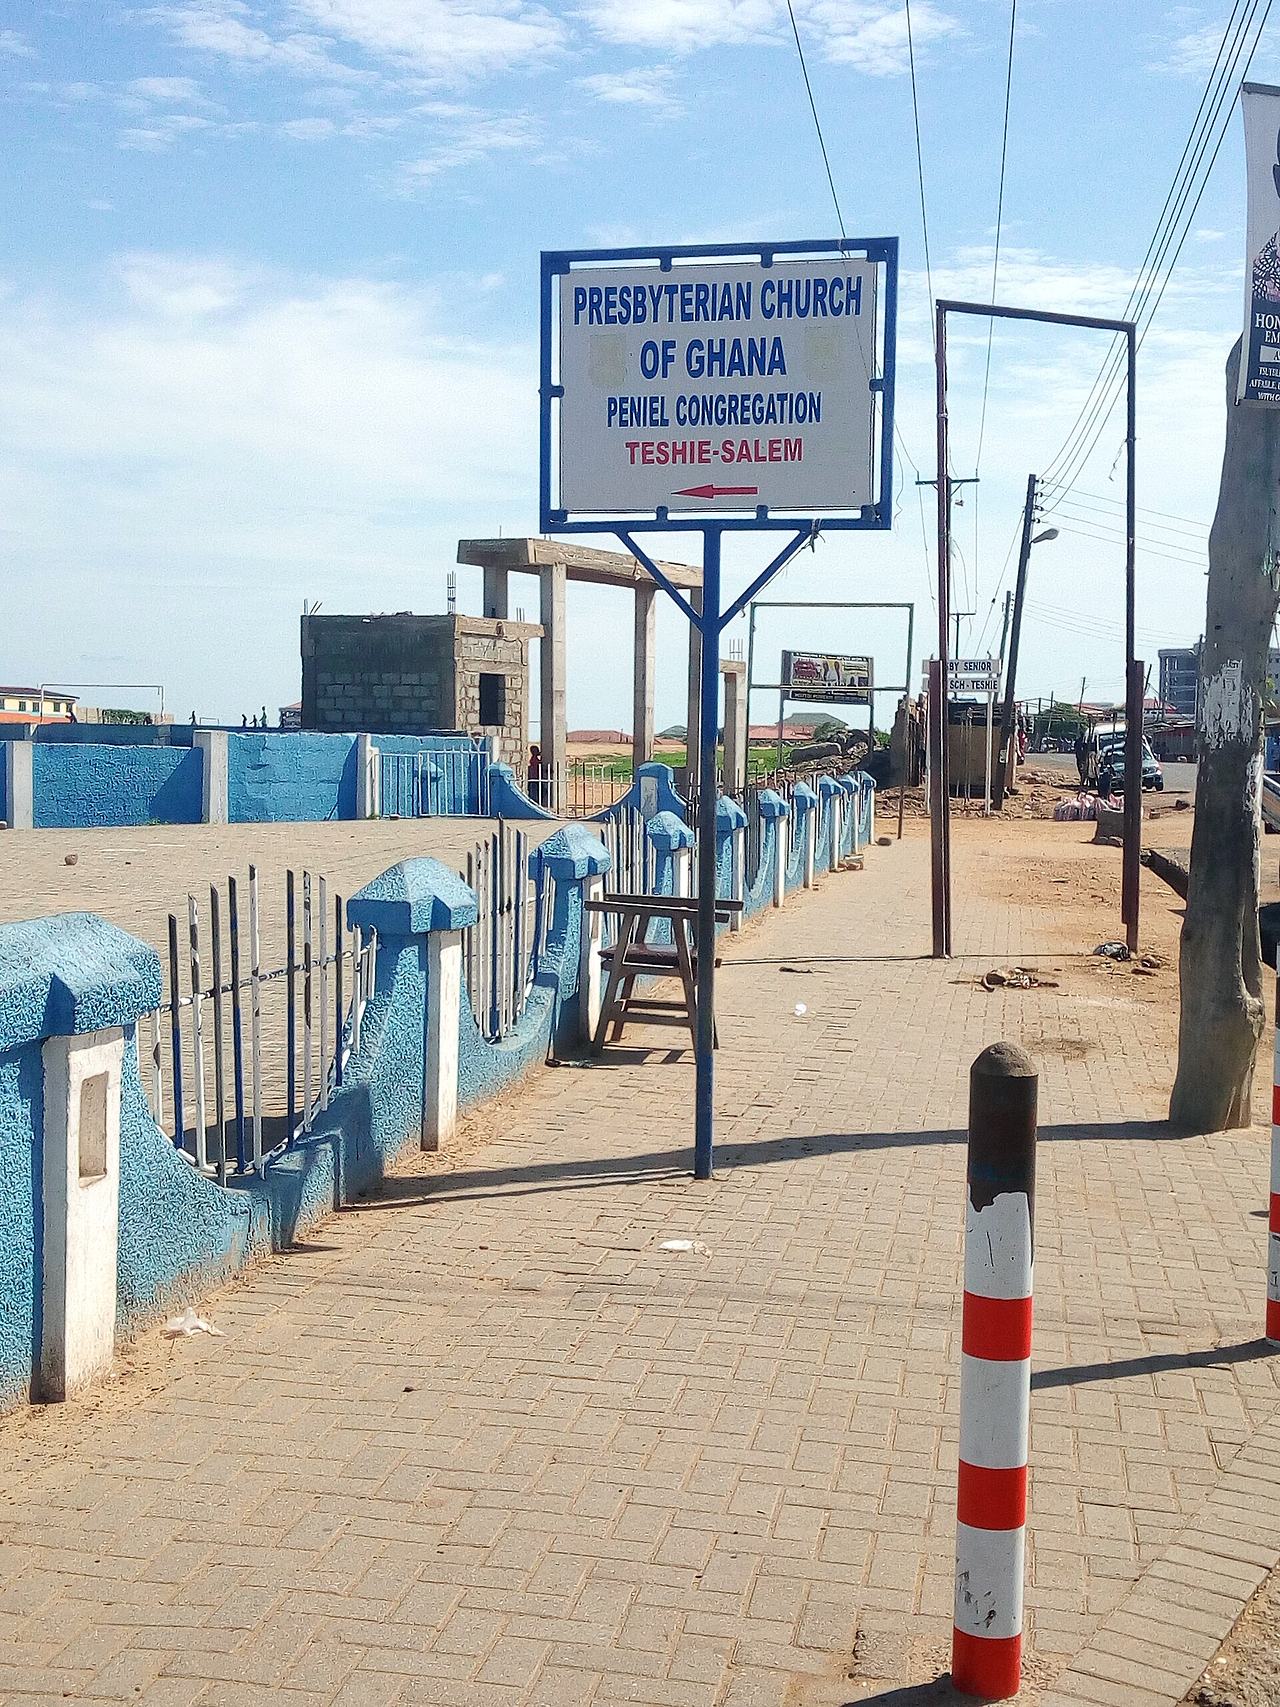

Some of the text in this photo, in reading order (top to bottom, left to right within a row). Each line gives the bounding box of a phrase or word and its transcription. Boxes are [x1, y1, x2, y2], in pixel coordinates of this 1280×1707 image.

[573, 276, 863, 325] PRESBYTERIAN CHURCH
[640, 336, 787, 379] OF GHANA
[607, 391, 822, 427] PENIEL CONGREGATION
[625, 438, 804, 466] TESHIE-SALEM
[963, 661, 992, 672] SENIOR
